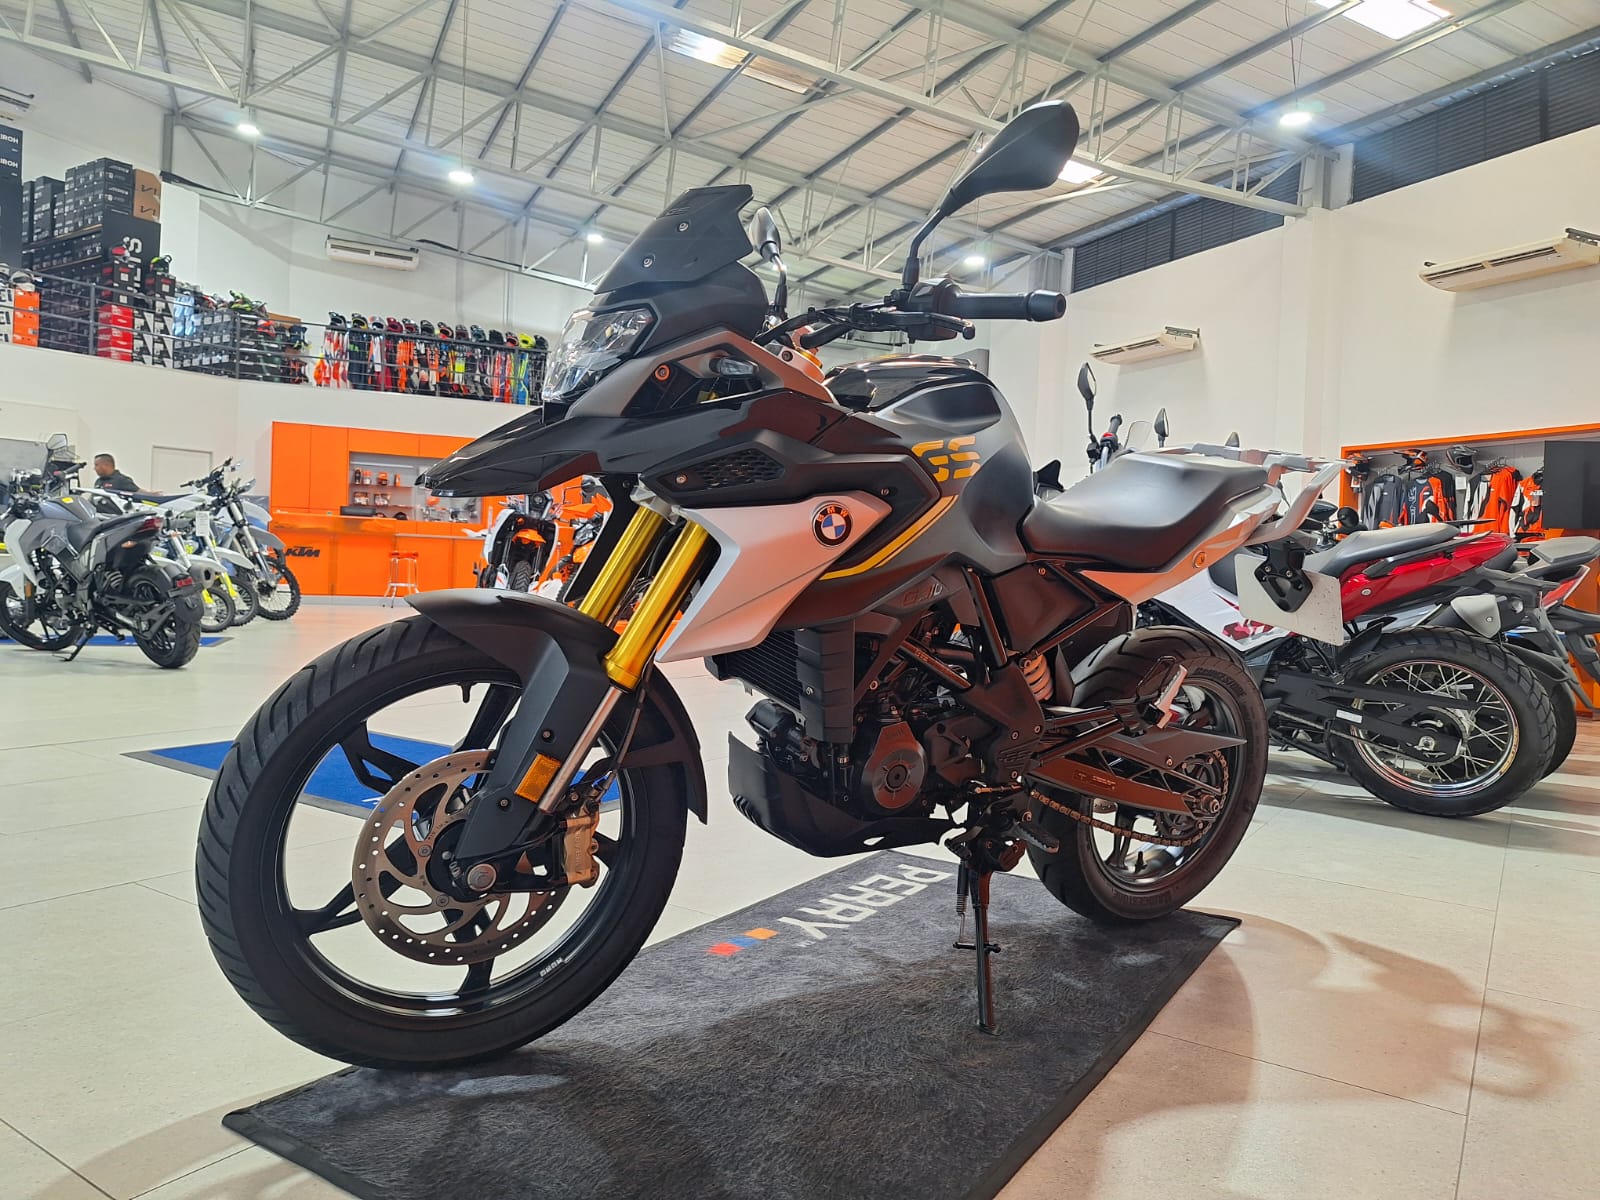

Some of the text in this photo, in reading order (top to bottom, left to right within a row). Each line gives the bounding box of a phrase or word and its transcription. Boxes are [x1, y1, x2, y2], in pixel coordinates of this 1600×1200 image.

[911, 435, 981, 482] GS
[816, 505, 849, 522] BMW
[285, 545, 321, 558] KTM
[776, 863, 953, 940] PERRY
